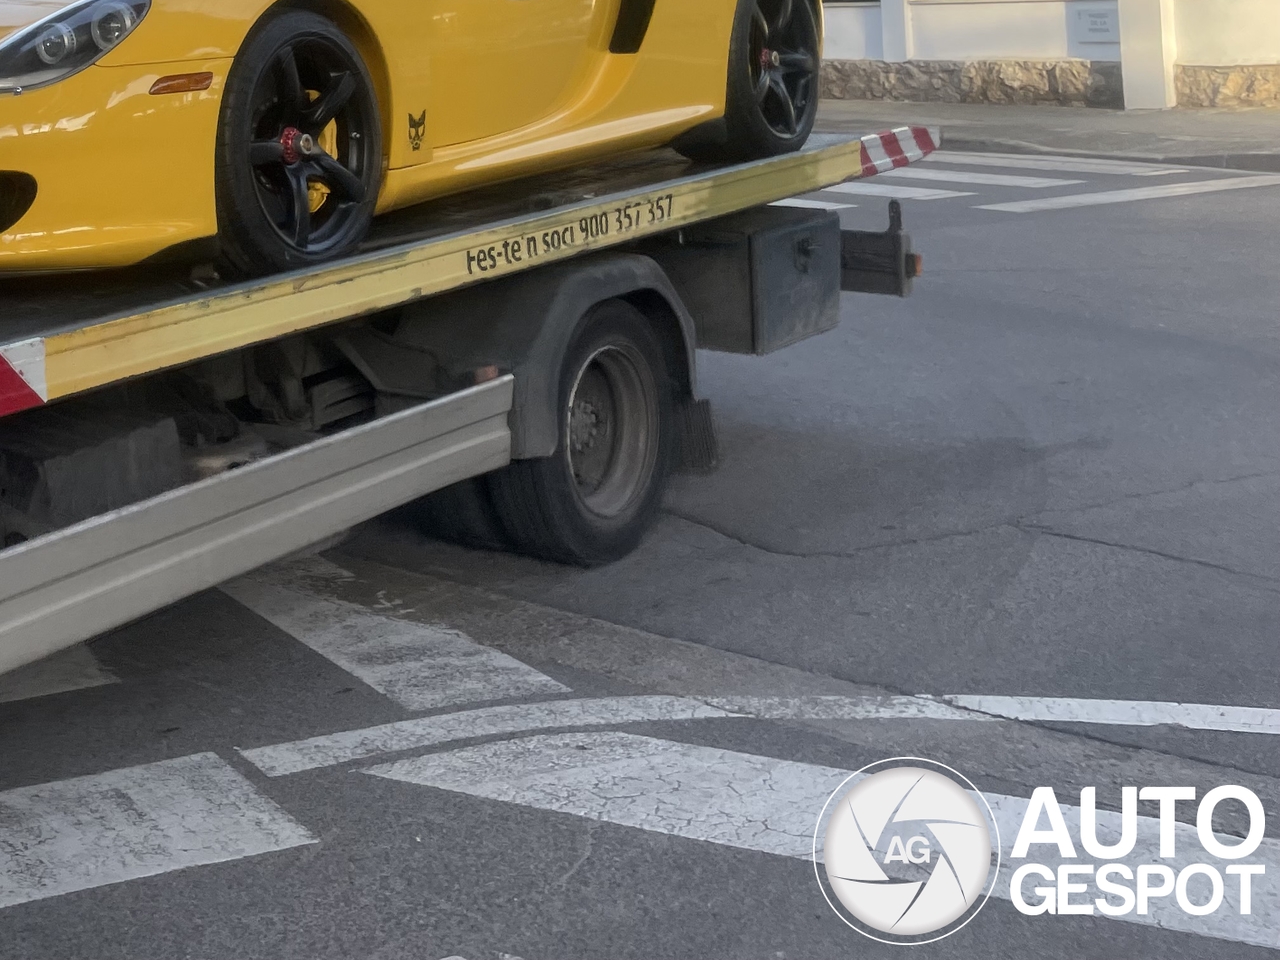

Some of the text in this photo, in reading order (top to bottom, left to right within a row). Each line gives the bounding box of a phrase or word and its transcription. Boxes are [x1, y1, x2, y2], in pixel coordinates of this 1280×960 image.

[579, 211, 609, 240] 900
[615, 202, 642, 233] 357
[648, 194, 673, 225] 357
